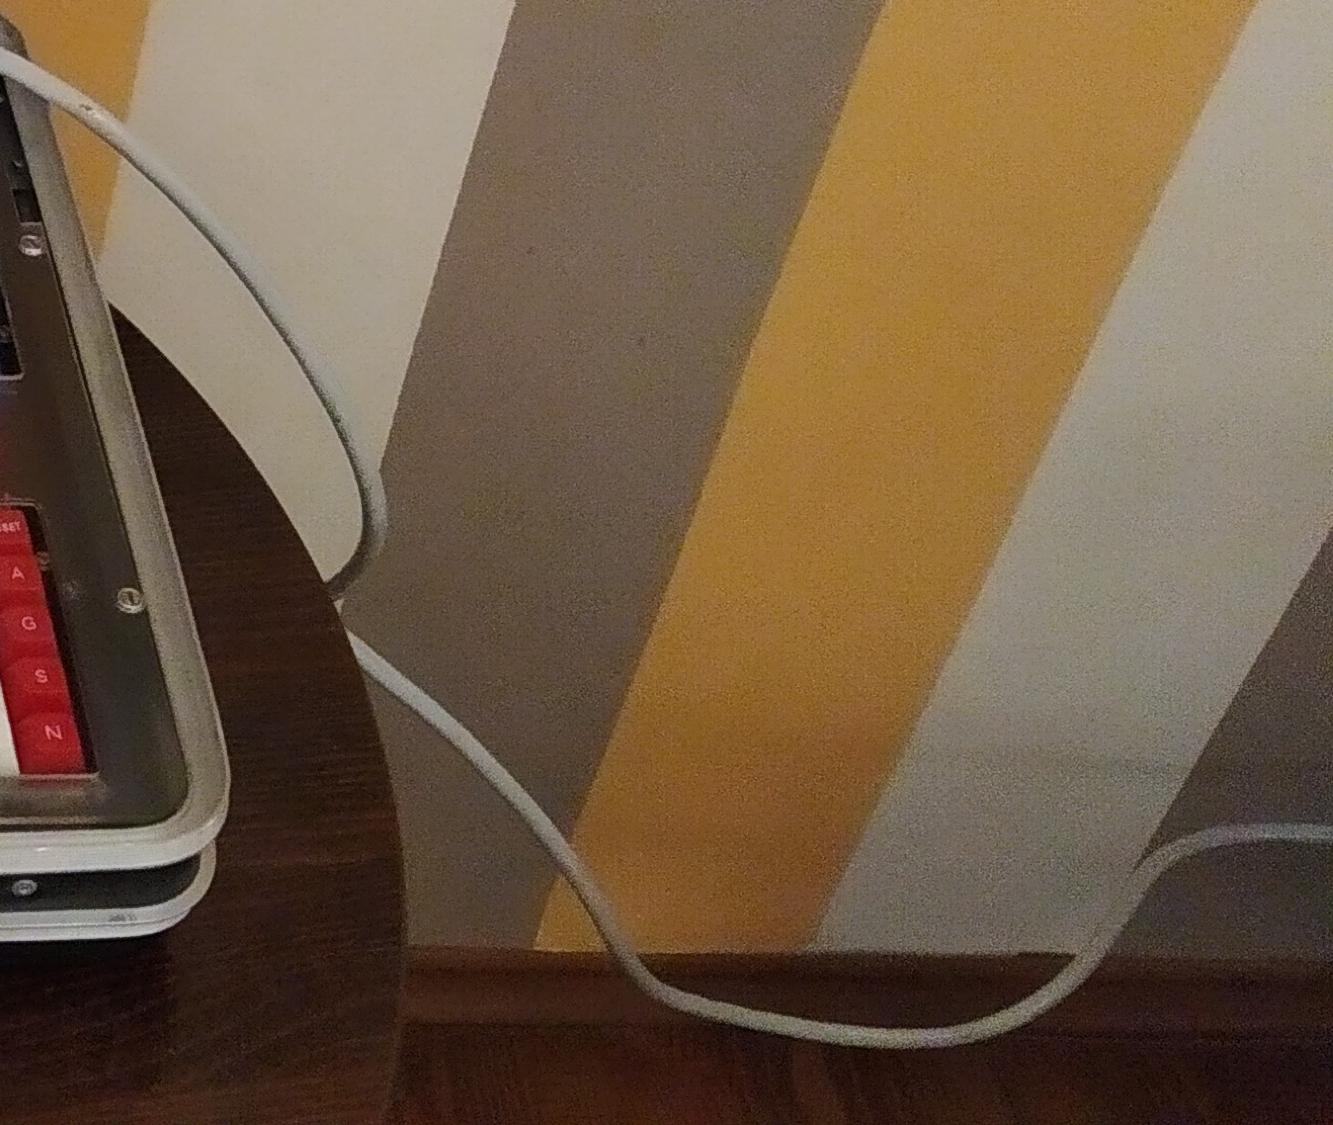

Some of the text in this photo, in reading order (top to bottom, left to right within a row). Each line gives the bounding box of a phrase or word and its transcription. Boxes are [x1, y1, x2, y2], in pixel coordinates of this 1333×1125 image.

[11, 566, 25, 580] A
[34, 669, 48, 683] S
[45, 725, 63, 741] N
